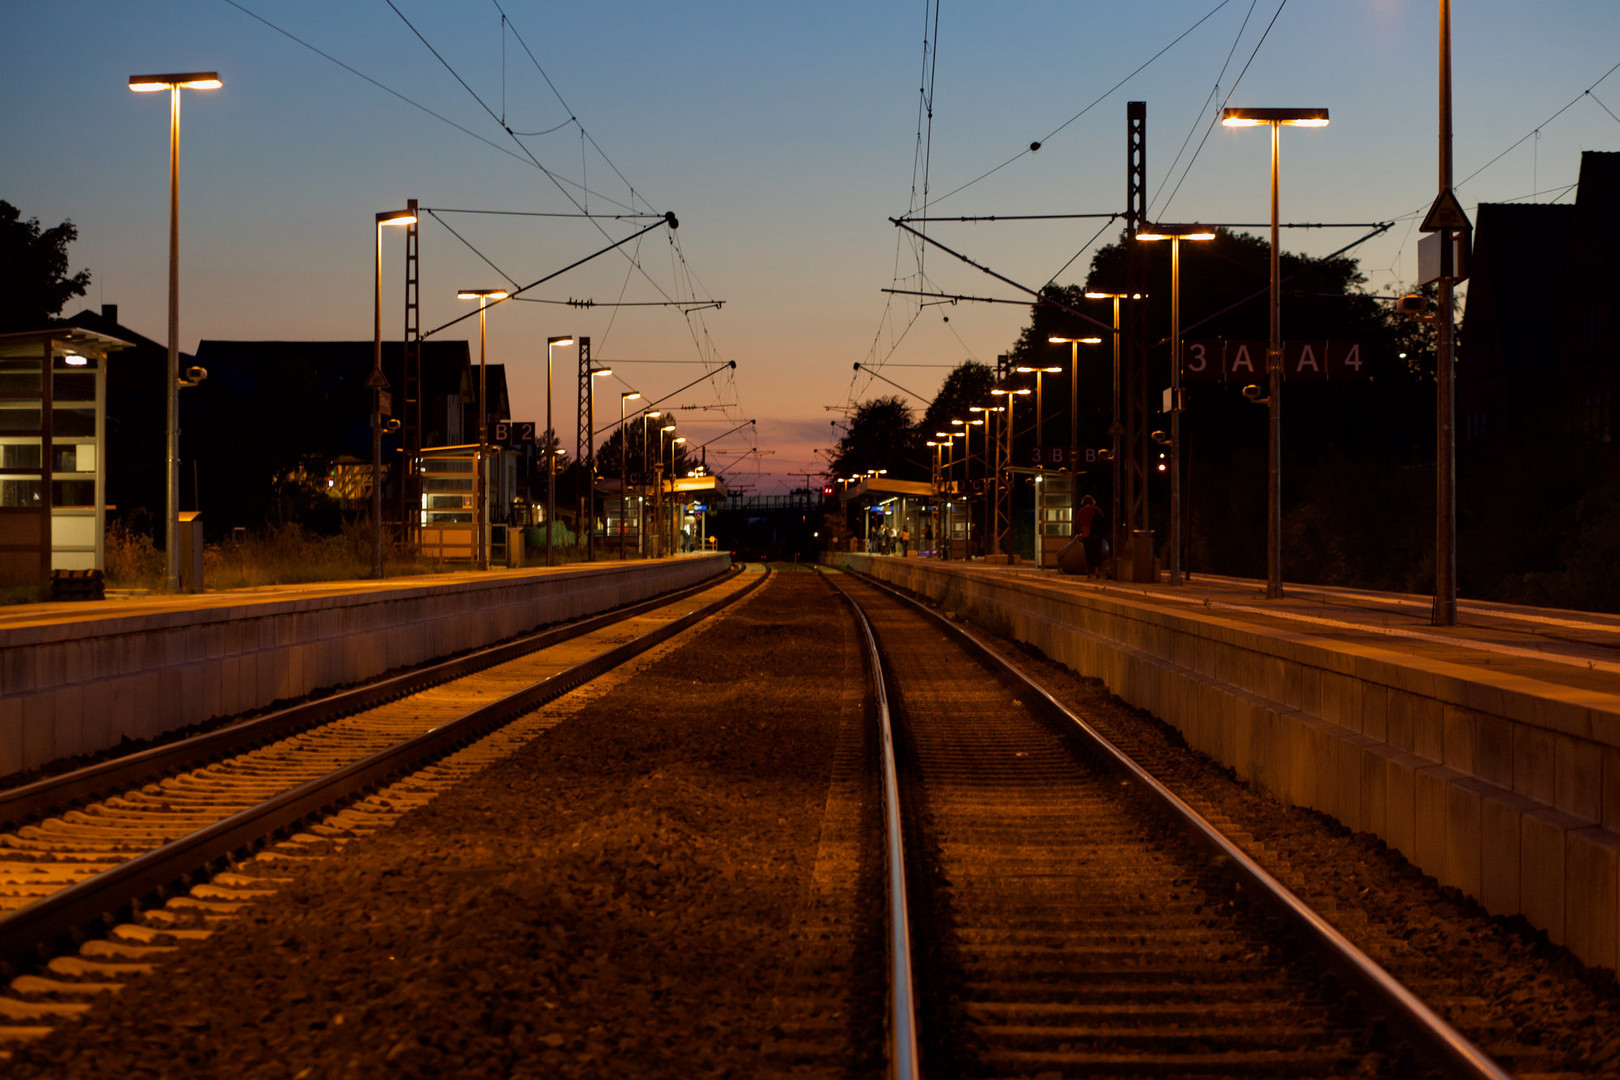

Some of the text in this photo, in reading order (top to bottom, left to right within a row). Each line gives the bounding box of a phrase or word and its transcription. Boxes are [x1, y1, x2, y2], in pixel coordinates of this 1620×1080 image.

[1188, 344, 1363, 372] 3 A A 4
[496, 424, 533, 440] B 2
[1031, 447, 1042, 463] 3
[1052, 448, 1063, 463] B
[1085, 448, 1097, 463] B
[645, 473, 653, 483] 2
